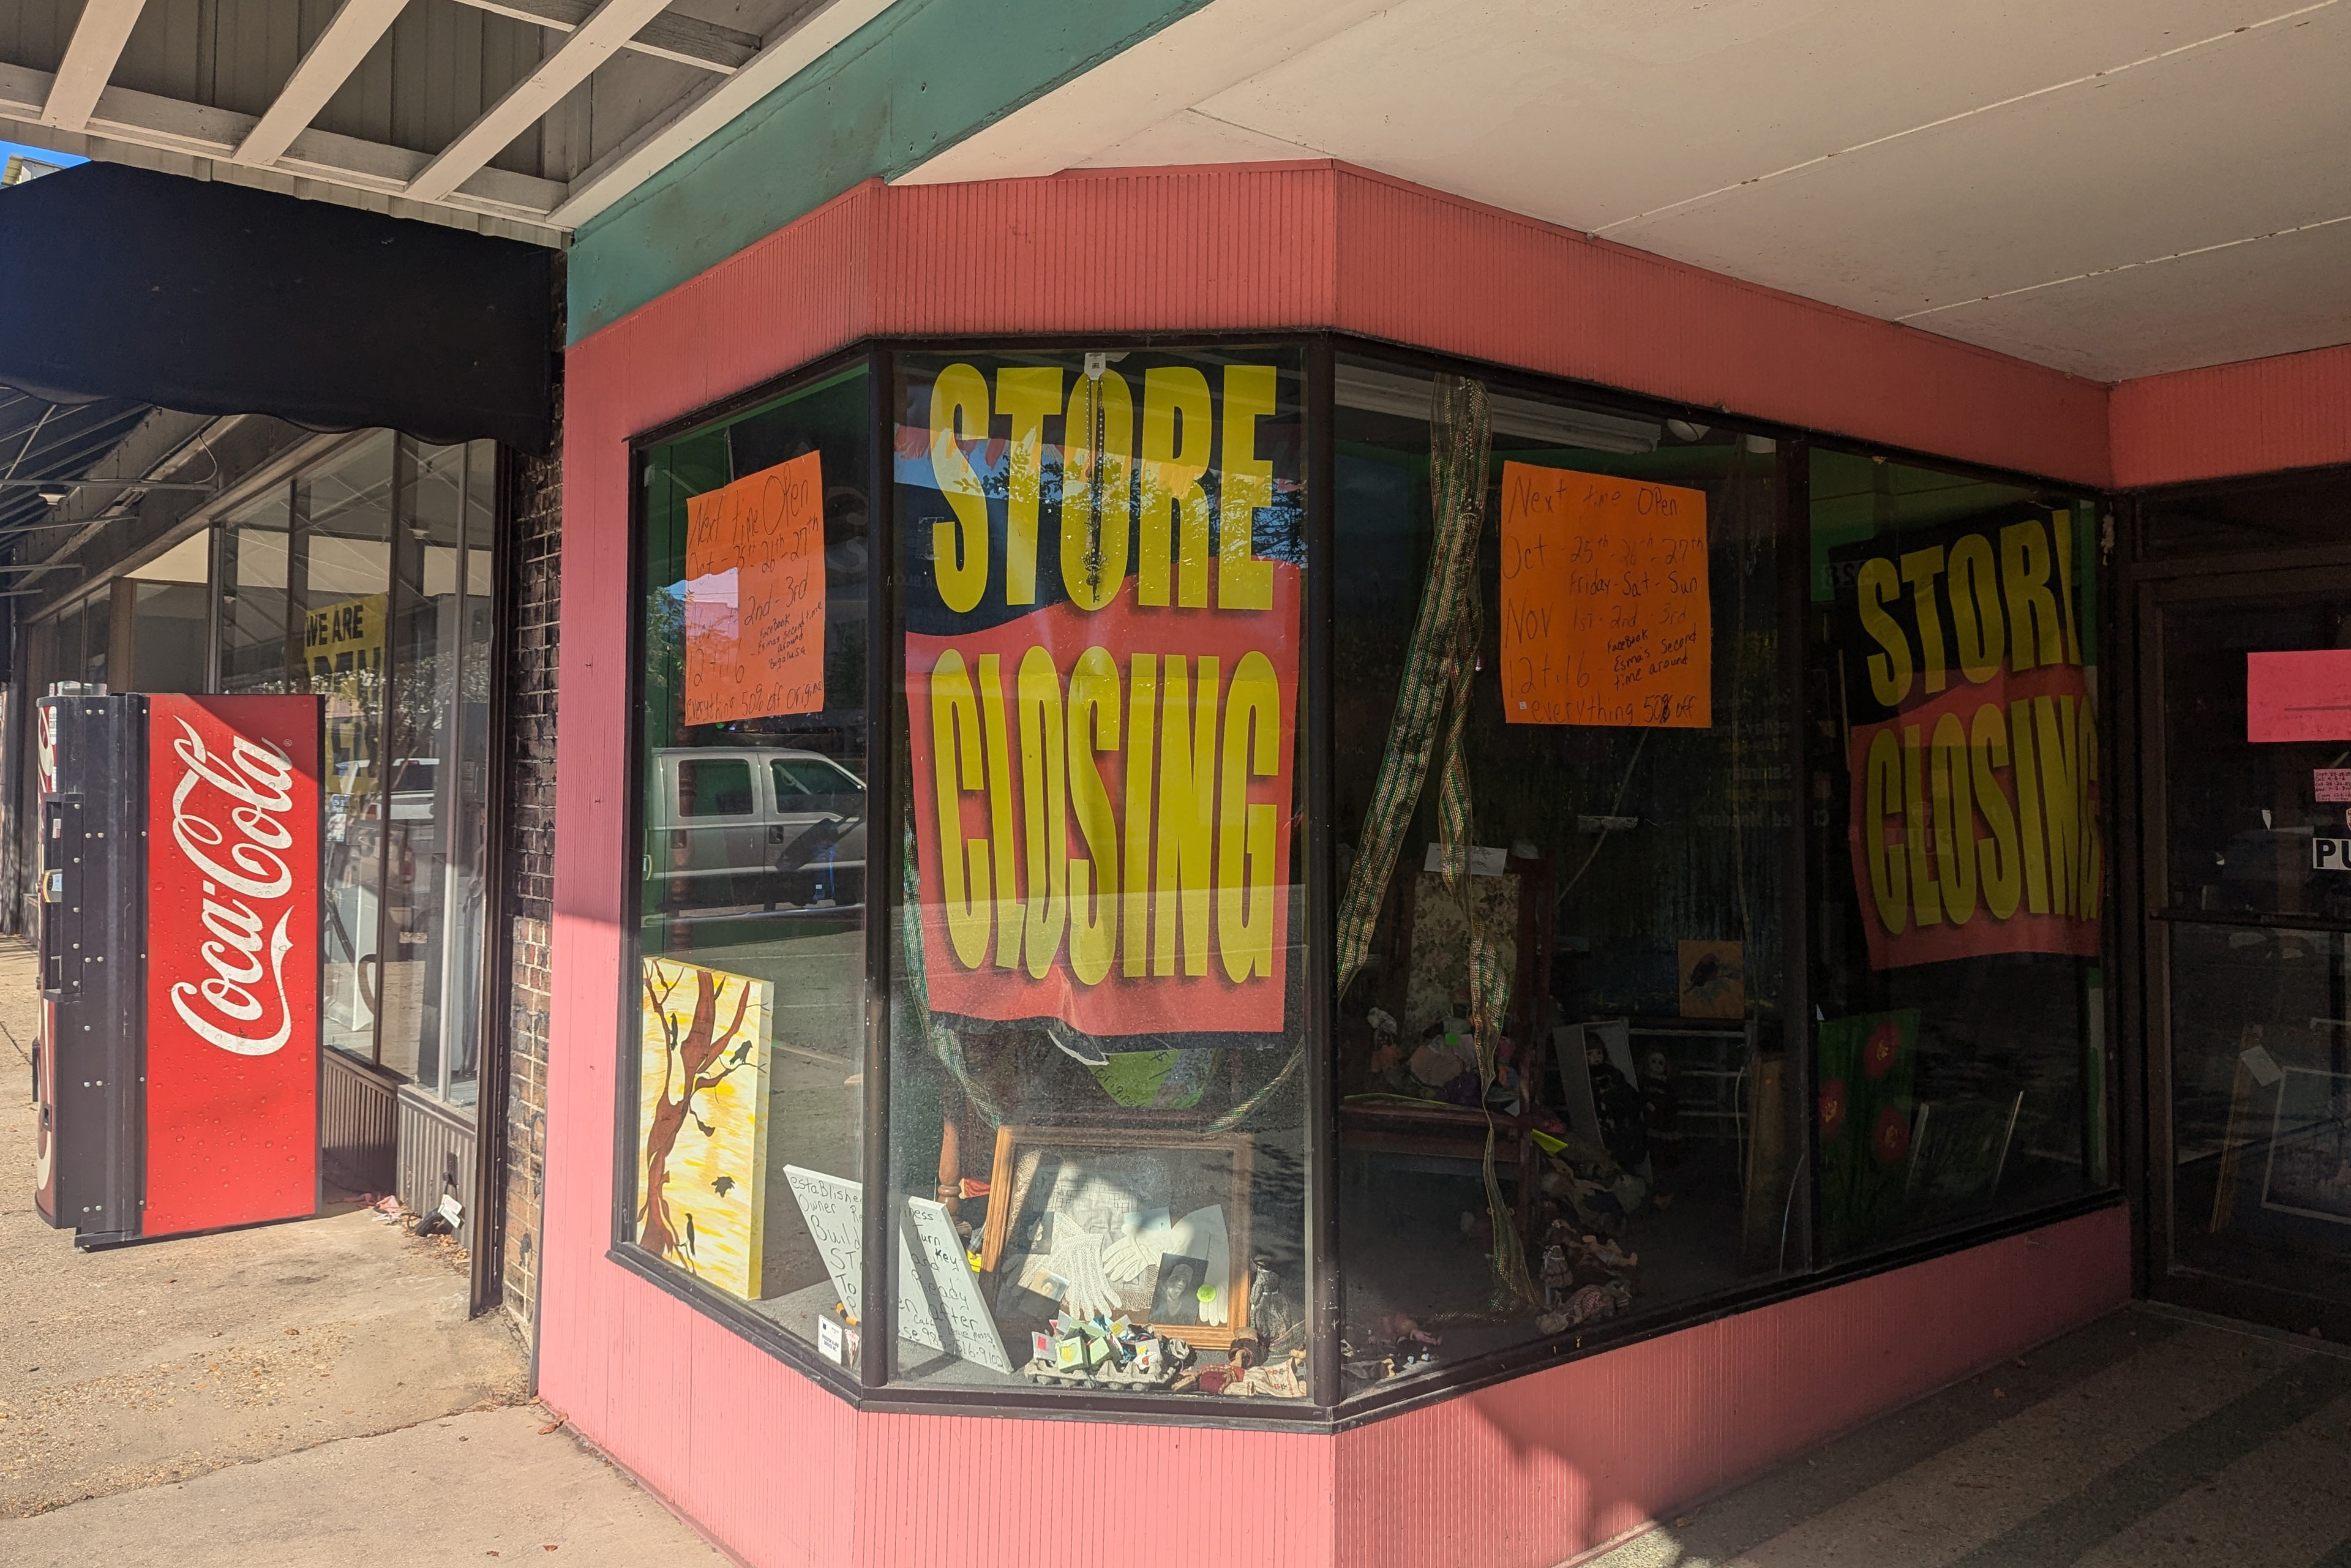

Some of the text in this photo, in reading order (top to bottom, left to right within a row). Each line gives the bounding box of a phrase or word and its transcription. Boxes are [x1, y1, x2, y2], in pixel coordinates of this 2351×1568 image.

[929, 364, 1276, 613] STORE
[1508, 476, 1566, 523] Next
[1583, 485, 1621, 509] time
[688, 495, 724, 549] Next
[732, 490, 758, 545] time
[1502, 533, 1547, 579] Oct
[1662, 536, 1703, 565] 27th
[744, 583, 773, 625] 2nd
[786, 560, 809, 607] 3rd
[1569, 568, 1697, 598] Friday Sat Sun
[306, 604, 364, 647] WE ARE
[1610, 604, 1637, 629] 2nd
[1614, 646, 1688, 691] time around
[1531, 690, 1633, 725] everything
[1676, 695, 1696, 719] off
[931, 645, 1280, 985] CLOSING
[1867, 694, 2099, 935] CLOSING
[171, 716, 294, 1056] Coca-Cola
[798, 1194, 836, 1214] Owner
[913, 1224, 940, 1247] Turn
